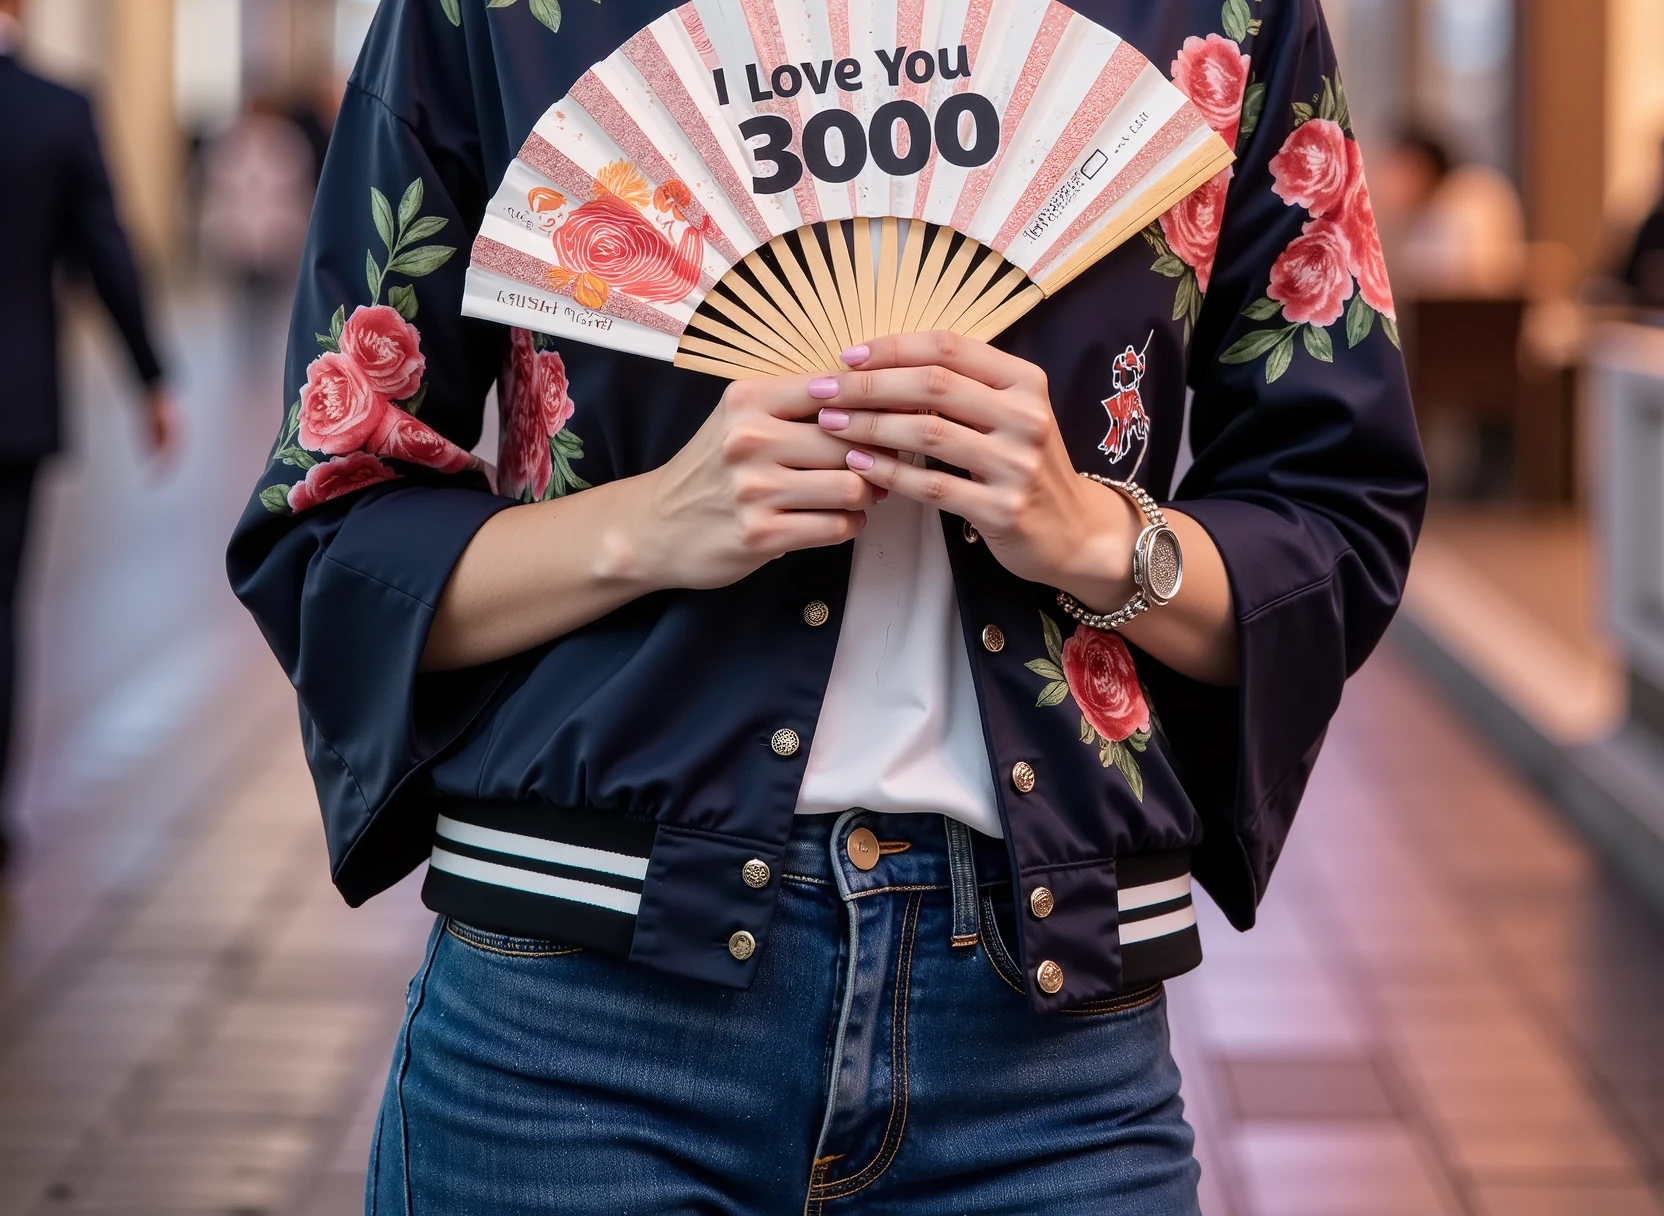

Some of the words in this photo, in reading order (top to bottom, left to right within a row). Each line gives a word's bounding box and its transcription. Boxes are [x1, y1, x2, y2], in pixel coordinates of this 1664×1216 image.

[712, 67, 730, 106] I
[745, 58, 863, 103] Love
[874, 45, 972, 87] You
[737, 92, 1000, 195] 3000
